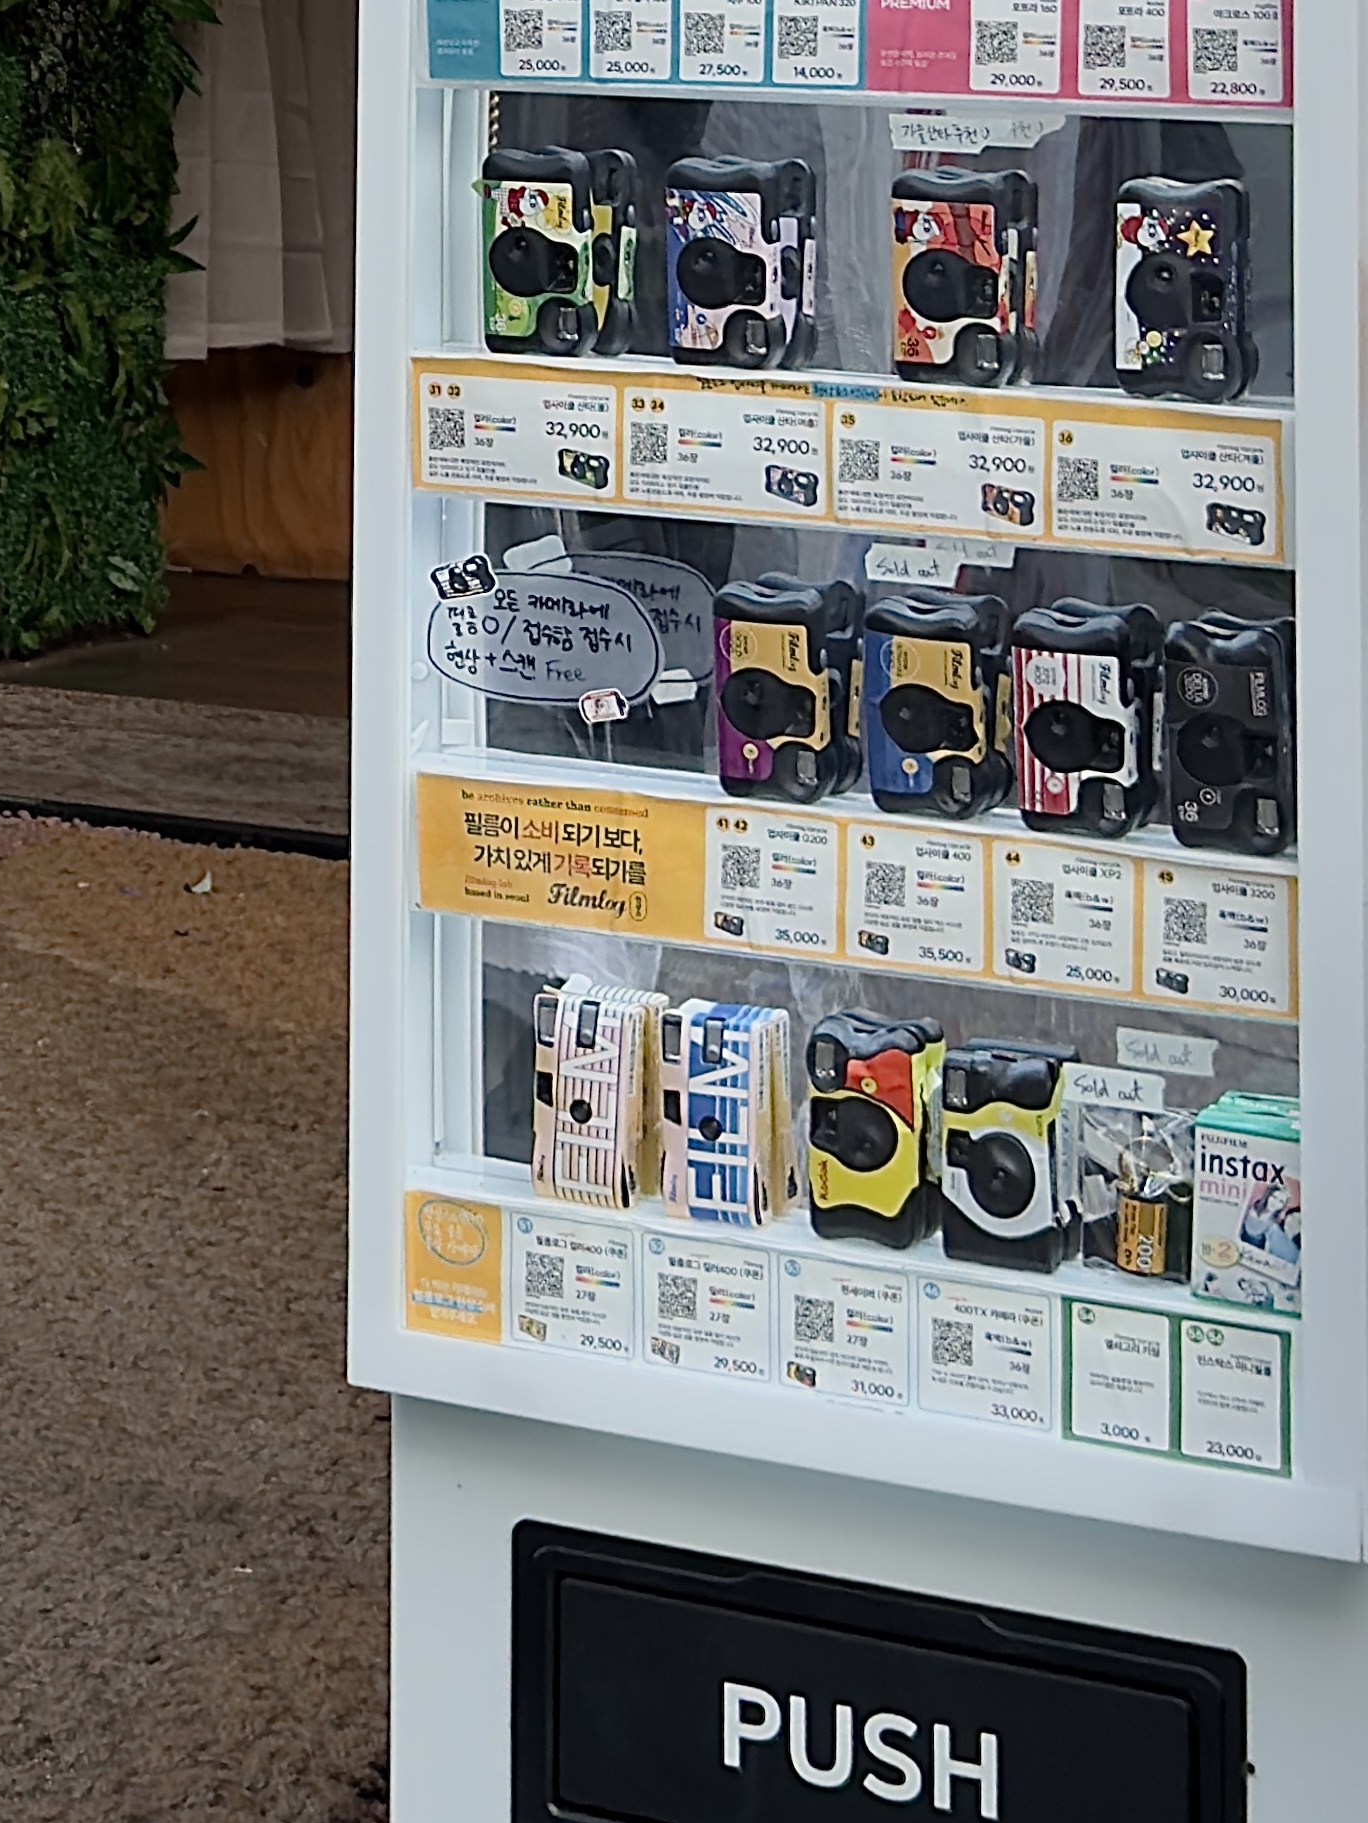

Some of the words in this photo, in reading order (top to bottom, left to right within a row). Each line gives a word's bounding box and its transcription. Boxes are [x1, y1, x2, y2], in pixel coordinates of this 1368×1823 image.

[1012, 3, 1037, 13] 포트라
[1041, 4, 1057, 13] 160
[1118, 7, 1143, 17] 포트라
[1145, 8, 1164, 17] 400
[542, 399, 575, 411] 업사이클
[473, 413, 516, 424] 컬러(color)
[743, 414, 775, 425] 업사이클
[678, 428, 722, 439] 컬러(color)
[958, 431, 989, 443] 업사이클
[992, 435, 1035, 446] 산타(가을)
[474, 438, 494, 448] 36장
[677, 453, 698, 463] 36장
[890, 445, 937, 457] 컬러(color)
[1181, 449, 1217, 461] 업사이클
[890, 471, 912, 481] 36장
[1110, 463, 1159, 476] 컬러(color)
[1110, 489, 1134, 501] 36장
[876, 558, 911, 579] Sold
[918, 559, 941, 577] out
[494, 589, 521, 612] 모든
[527, 594, 610, 620] 카메라에
[446, 607, 478, 636] 필름
[579, 627, 632, 654] 접수시
[445, 641, 481, 674] 현상
[500, 651, 536, 681] 스캔
[546, 659, 587, 682] Free
[462, 790, 474, 800] be
[527, 798, 563, 810] rather
[565, 800, 591, 812] than
[1184, 801, 1199, 822] 36
[464, 811, 519, 840] 필름이
[522, 819, 559, 844] 소비
[562, 823, 599, 848] 되기
[603, 826, 643, 855] 보다,
[474, 844, 511, 870] 가치
[514, 849, 550, 874] 있게
[772, 853, 817, 867] 컬러(color)
[916, 846, 950, 859] 업사이클
[952, 851, 972, 861] 400
[917, 870, 965, 884] 컬러(color)
[1062, 864, 1097, 877] 업사이클
[771, 878, 792, 890] 36장
[1212, 882, 1247, 896] 업사이클
[1250, 890, 1276, 900] 3200
[547, 883, 626, 919] Filmlog
[917, 896, 939, 908] 36장
[1089, 919, 1112, 931] 36장
[1243, 938, 1267, 951] 36장
[1073, 1074, 1109, 1098] Sold
[1118, 1079, 1143, 1102] out
[554, 1010, 622, 1196] FILM
[686, 1025, 751, 1213] FILM
[1200, 1146, 1285, 1185] instax
[1200, 1178, 1247, 1200] mini
[1137, 1235, 1154, 1271] 200
[575, 1264, 620, 1279] 컬러(color)
[576, 1290, 596, 1302] 27장
[954, 1303, 988, 1318] 400TX
[722, 1681, 1000, 1822] PUSH
